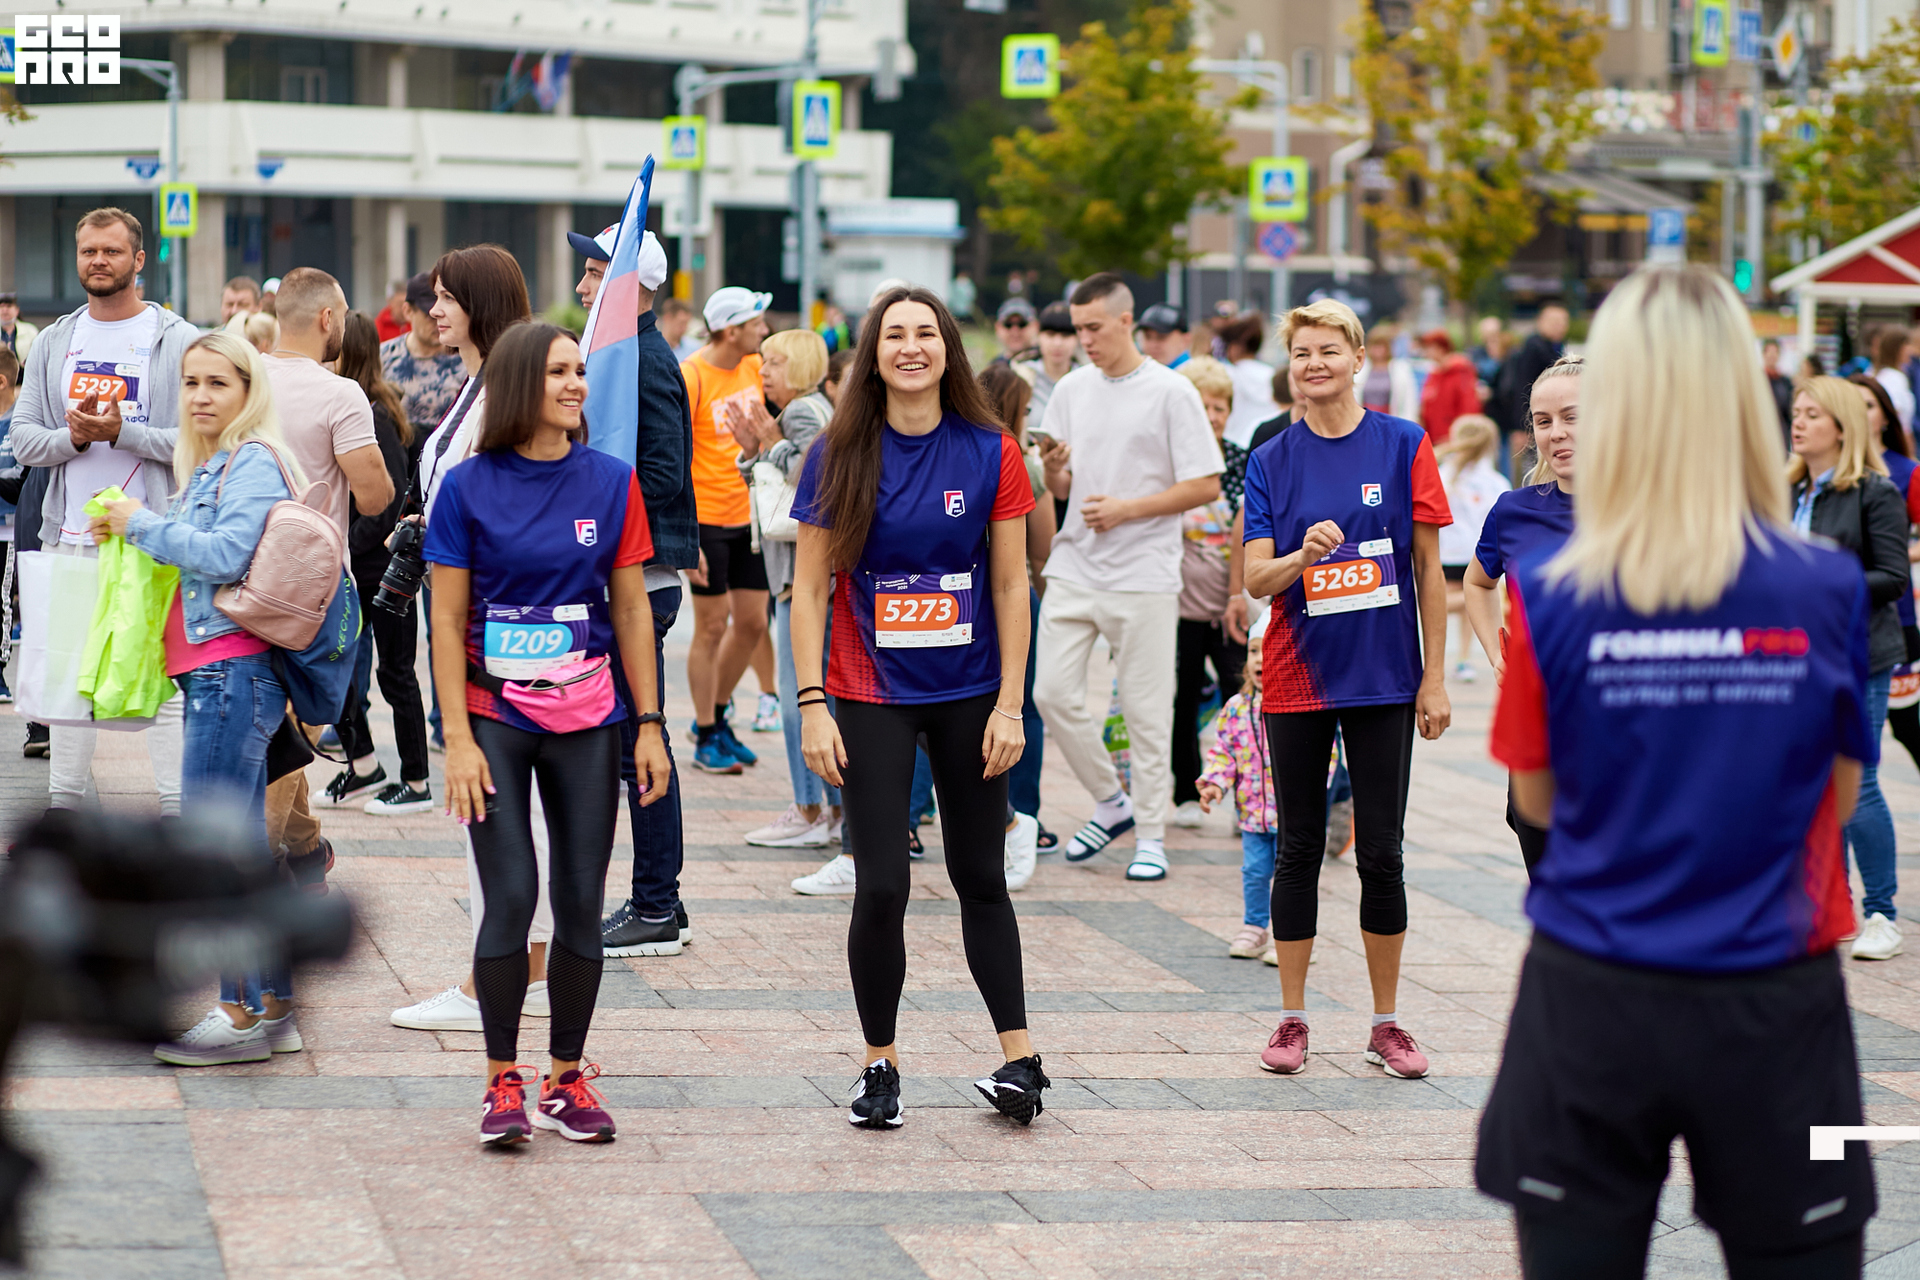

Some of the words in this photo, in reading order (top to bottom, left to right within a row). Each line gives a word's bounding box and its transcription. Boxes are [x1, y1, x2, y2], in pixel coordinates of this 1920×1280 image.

[74, 377, 124, 396] 5297
[1311, 563, 1374, 592] 5263
[883, 598, 952, 622] 5273
[500, 629, 564, 654] 1209
